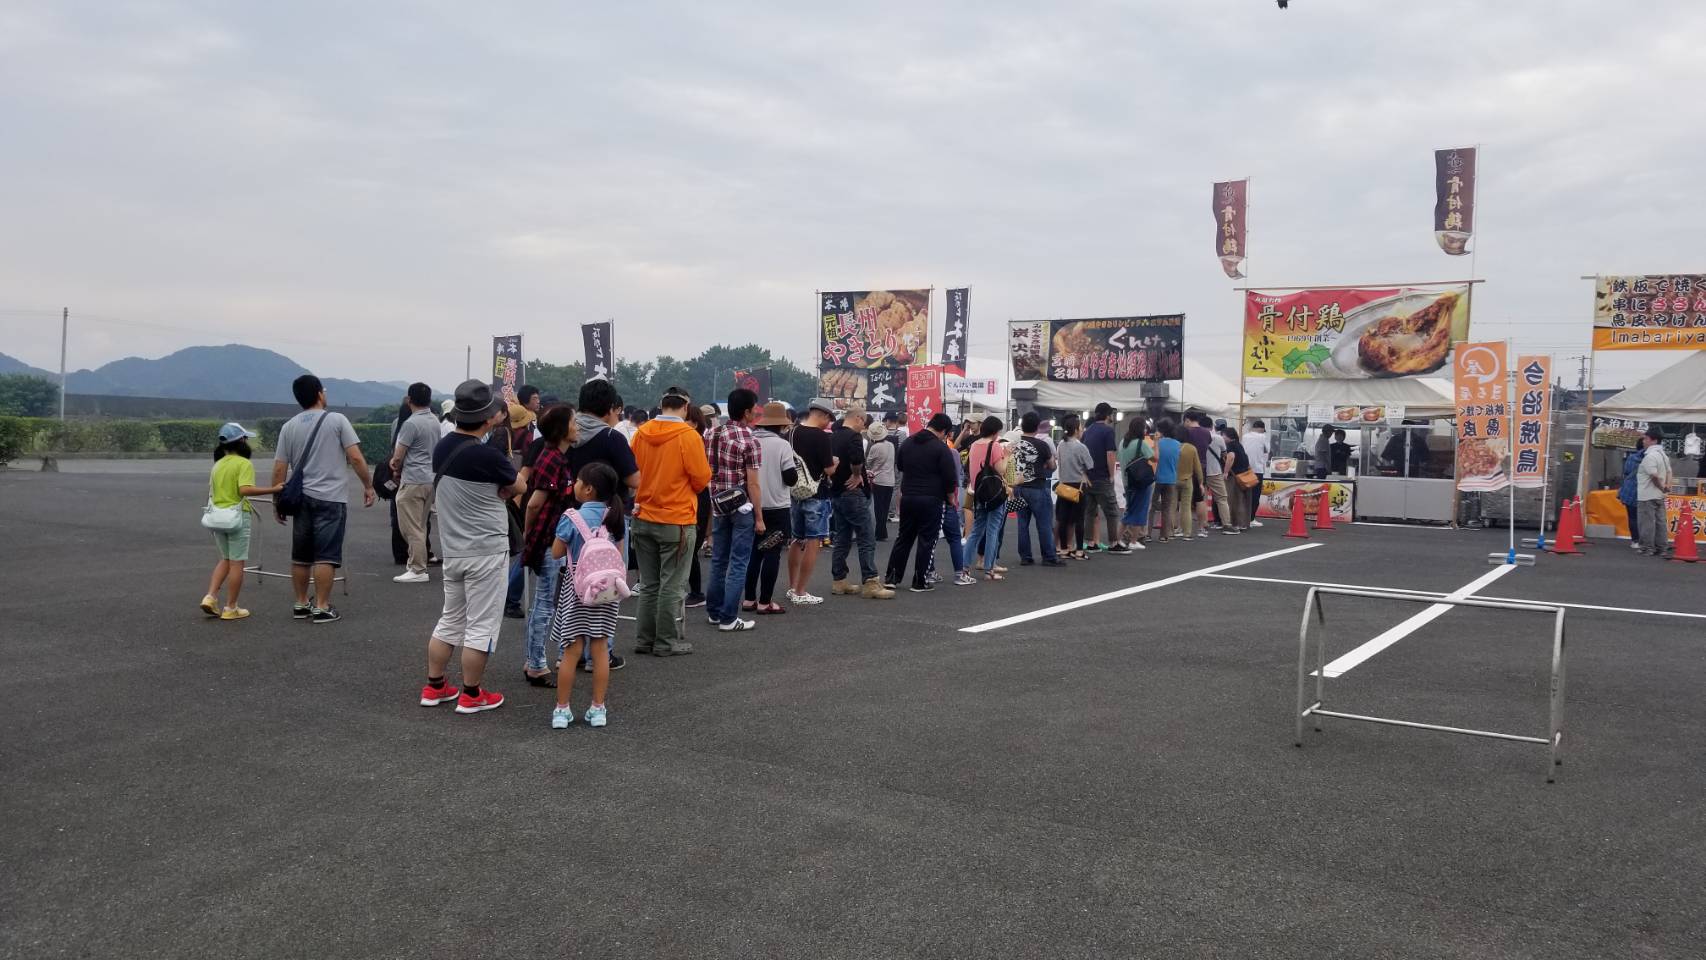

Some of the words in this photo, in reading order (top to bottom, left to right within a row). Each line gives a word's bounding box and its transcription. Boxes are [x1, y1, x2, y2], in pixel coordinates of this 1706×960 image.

[1611, 279, 1706, 293] 鉄板で焼く
[825, 316, 838, 340] 元祖
[837, 306, 878, 339] 長州
[1257, 302, 1345, 334] 骨付鶏
[823, 328, 898, 366] やきとり
